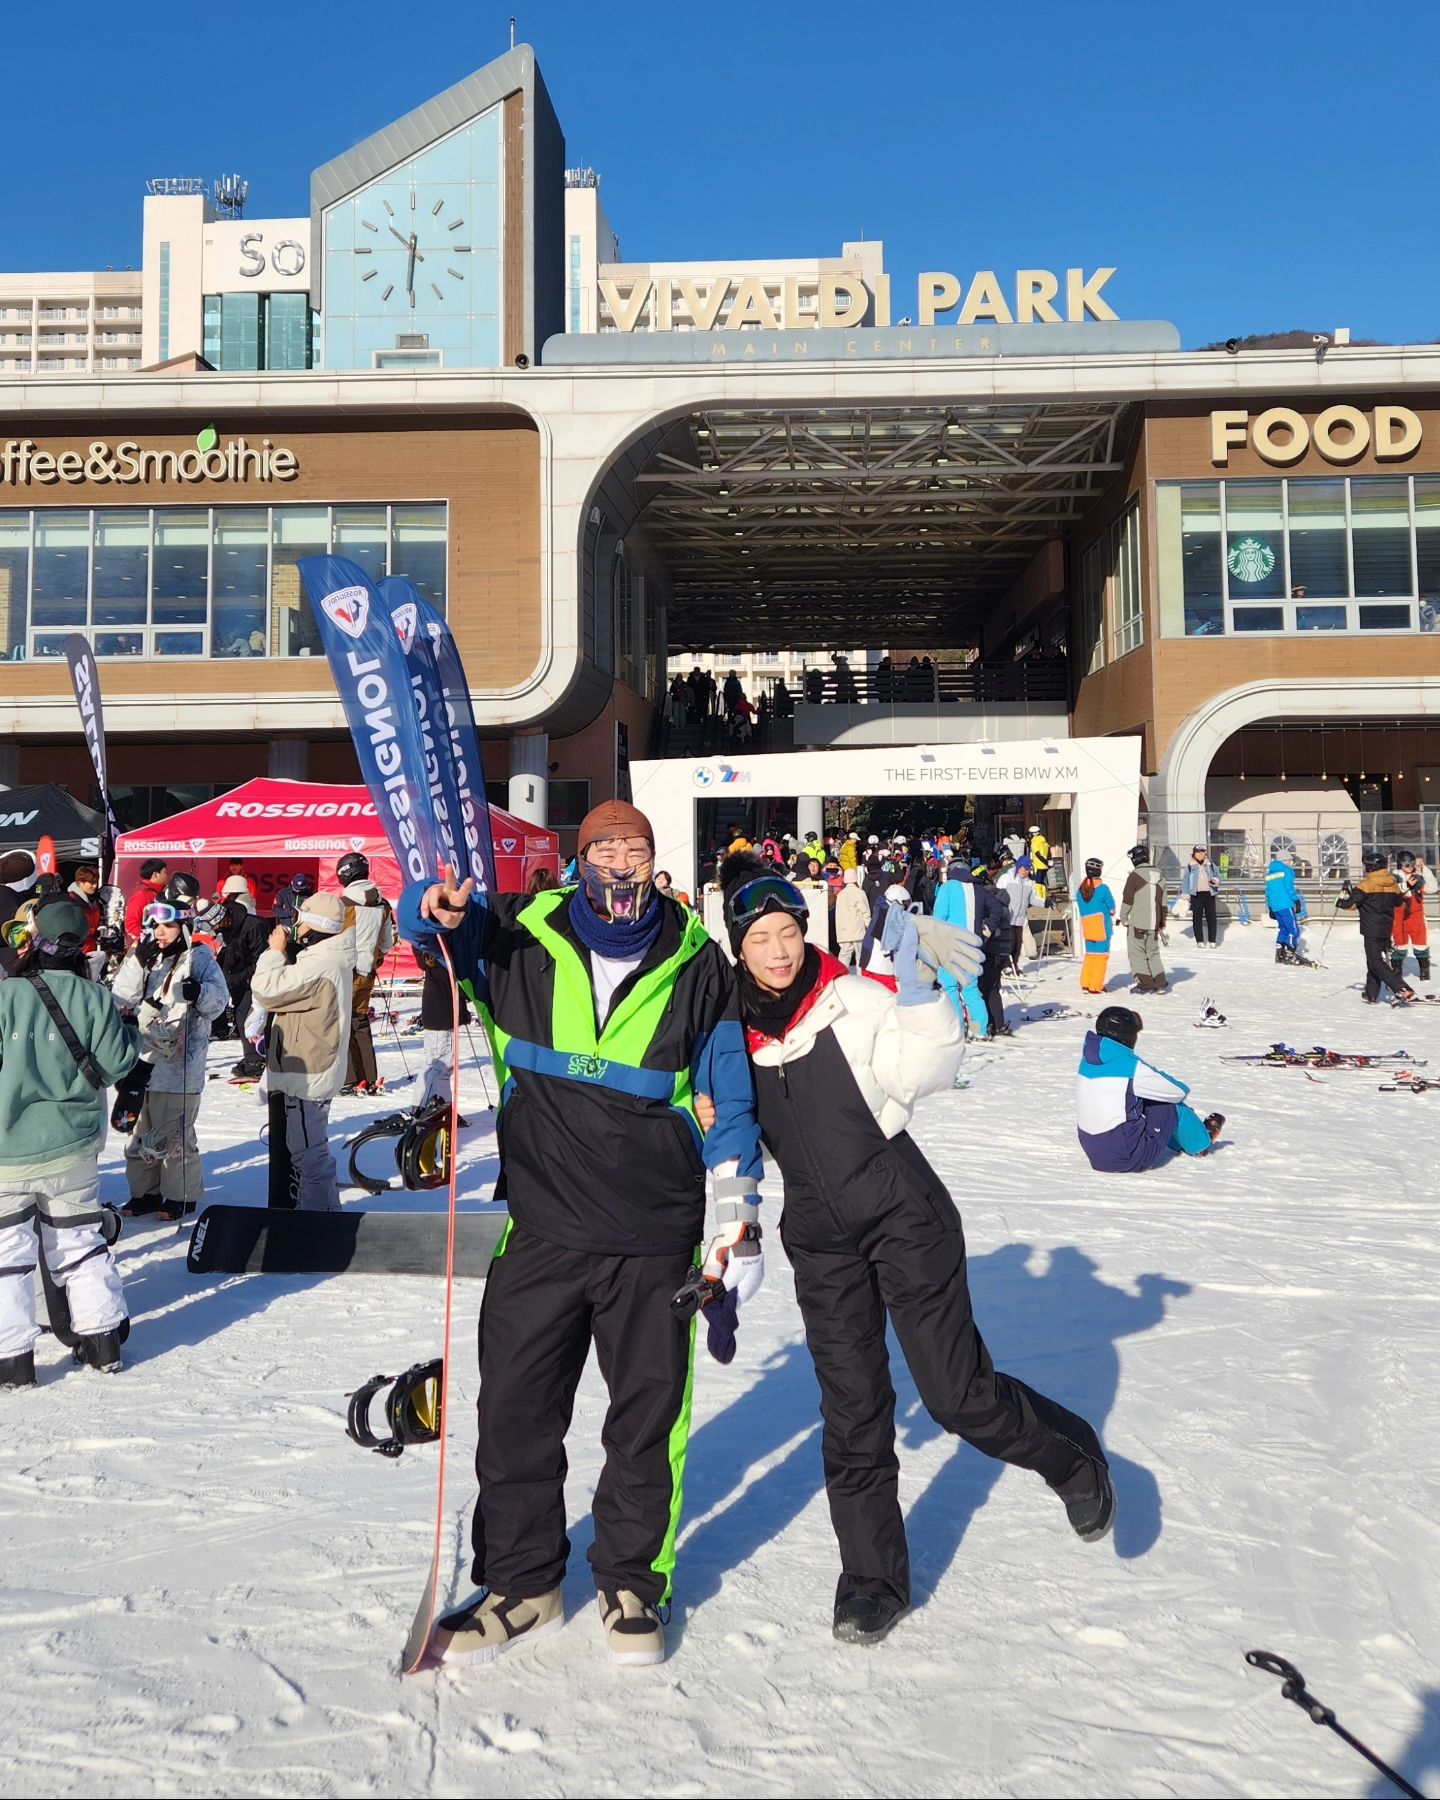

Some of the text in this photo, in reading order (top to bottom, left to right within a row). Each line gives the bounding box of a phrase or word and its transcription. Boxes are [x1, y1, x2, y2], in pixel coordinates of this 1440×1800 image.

[238, 232, 306, 278] SO
[598, 266, 1121, 333] VIVALDI PARK
[712, 337, 992, 355] MAIN CENTER
[1210, 404, 1424, 464] FOOD
[0, 437, 298, 483] ffee&Smoothie
[884, 766, 1079, 781] THE FIRST-EVER BMW XM
[216, 802, 380, 818] ROSSIGNO
[124, 840, 188, 852] ROSSIGNOL
[284, 839, 349, 851] ROSSIGNOL
